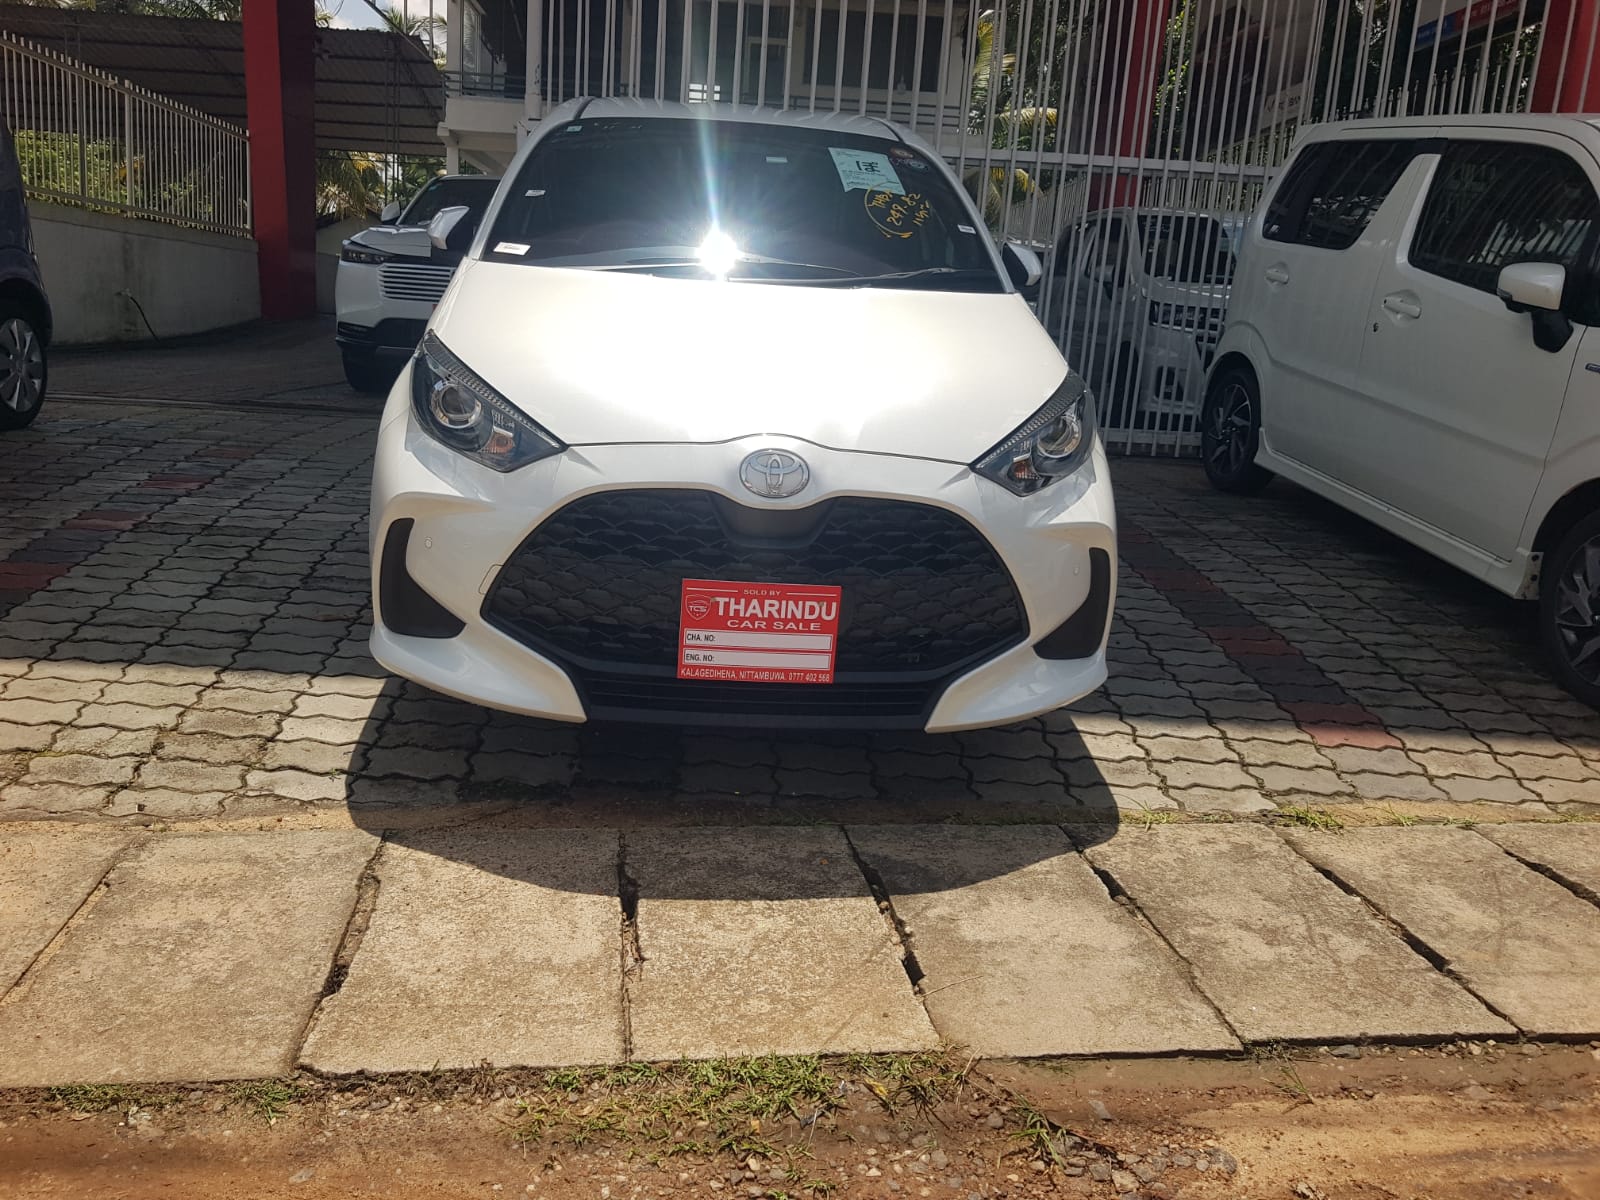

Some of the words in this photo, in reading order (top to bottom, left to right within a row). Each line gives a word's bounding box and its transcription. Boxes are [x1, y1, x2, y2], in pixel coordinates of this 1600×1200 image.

[714, 596, 837, 621] THARINDU
[727, 619, 767, 630] CAR
[772, 621, 822, 631] SALE
[686, 633, 702, 642] CHA.
[704, 634, 716, 642] NO:
[685, 653, 702, 662] ENG.
[702, 654, 715, 662] NO:
[788, 672, 804, 681] 0777
[805, 674, 818, 682] 402
